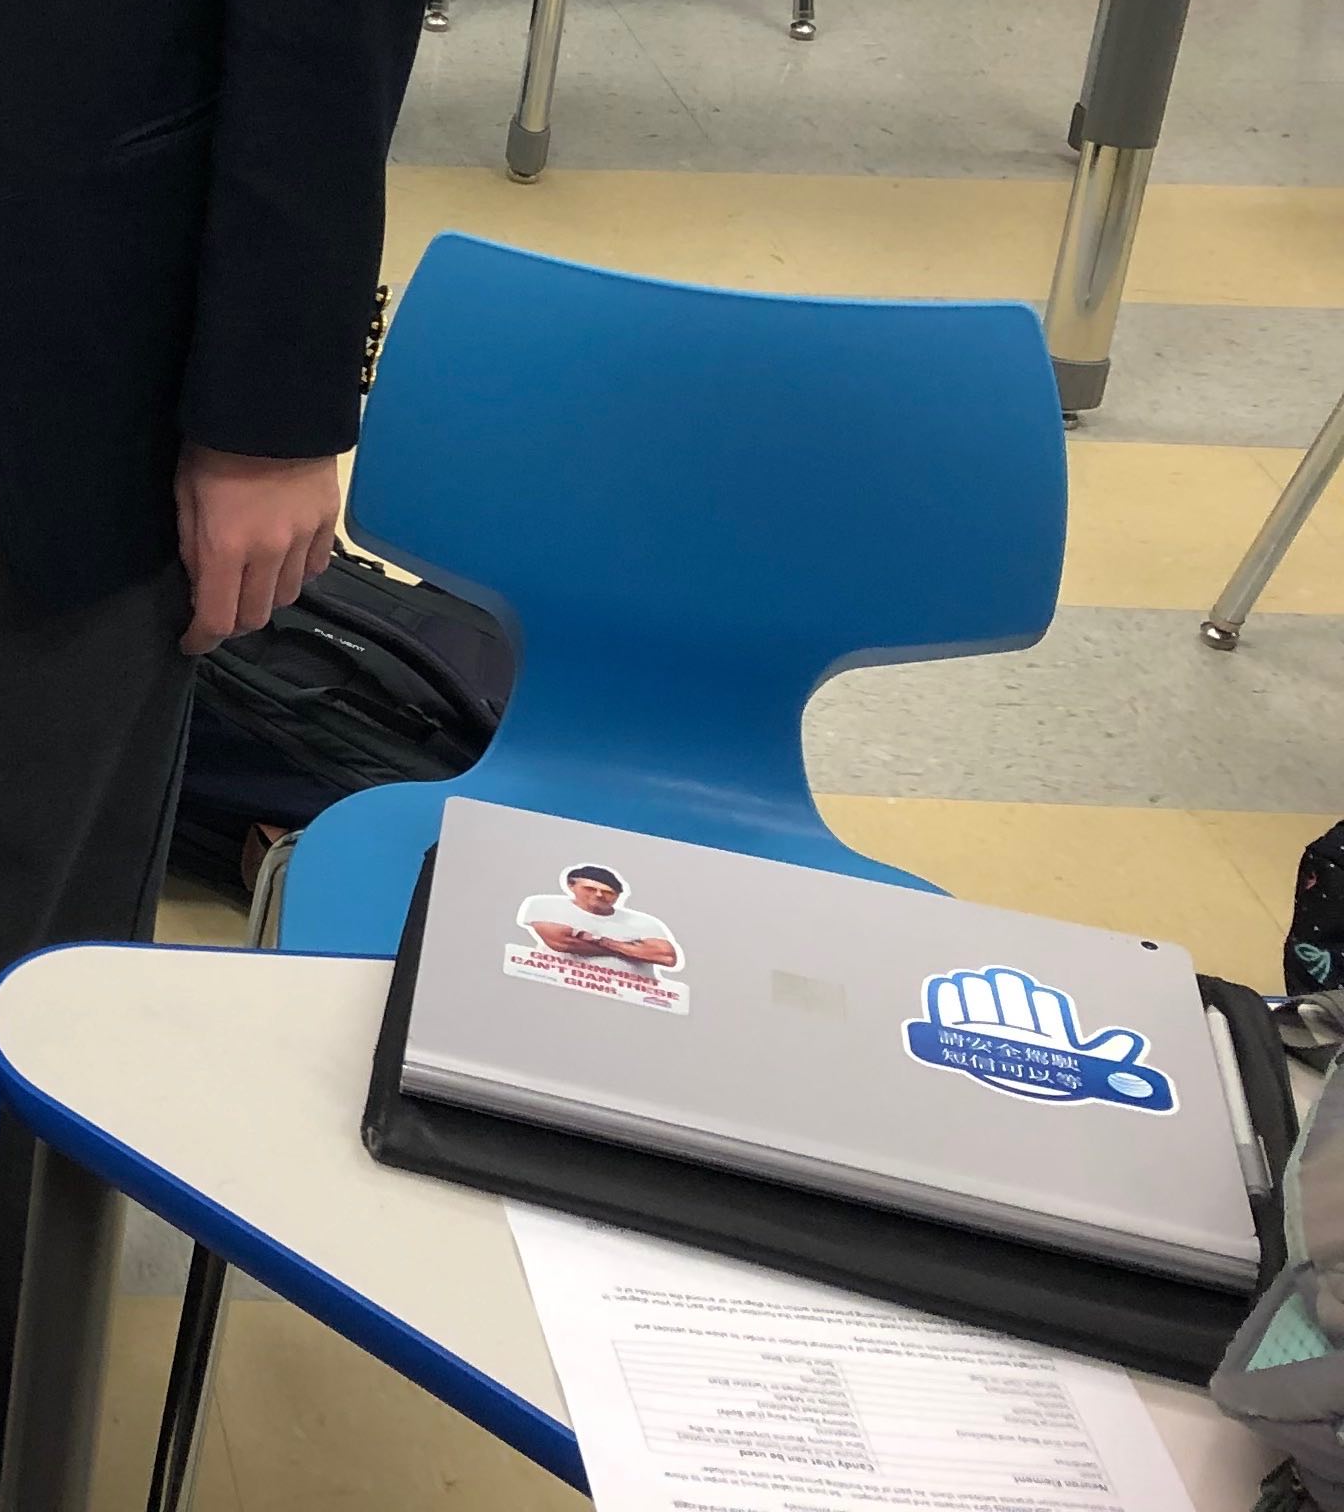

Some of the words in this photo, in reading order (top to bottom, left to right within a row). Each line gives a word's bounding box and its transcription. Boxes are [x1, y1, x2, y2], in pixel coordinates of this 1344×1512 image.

[510, 955, 565, 974] CAN'T
[570, 969, 612, 984] BAN
[615, 978, 681, 1001] THESE
[529, 951, 661, 987] GOVERNMENT
[837, 1457, 875, 1473] Candy
